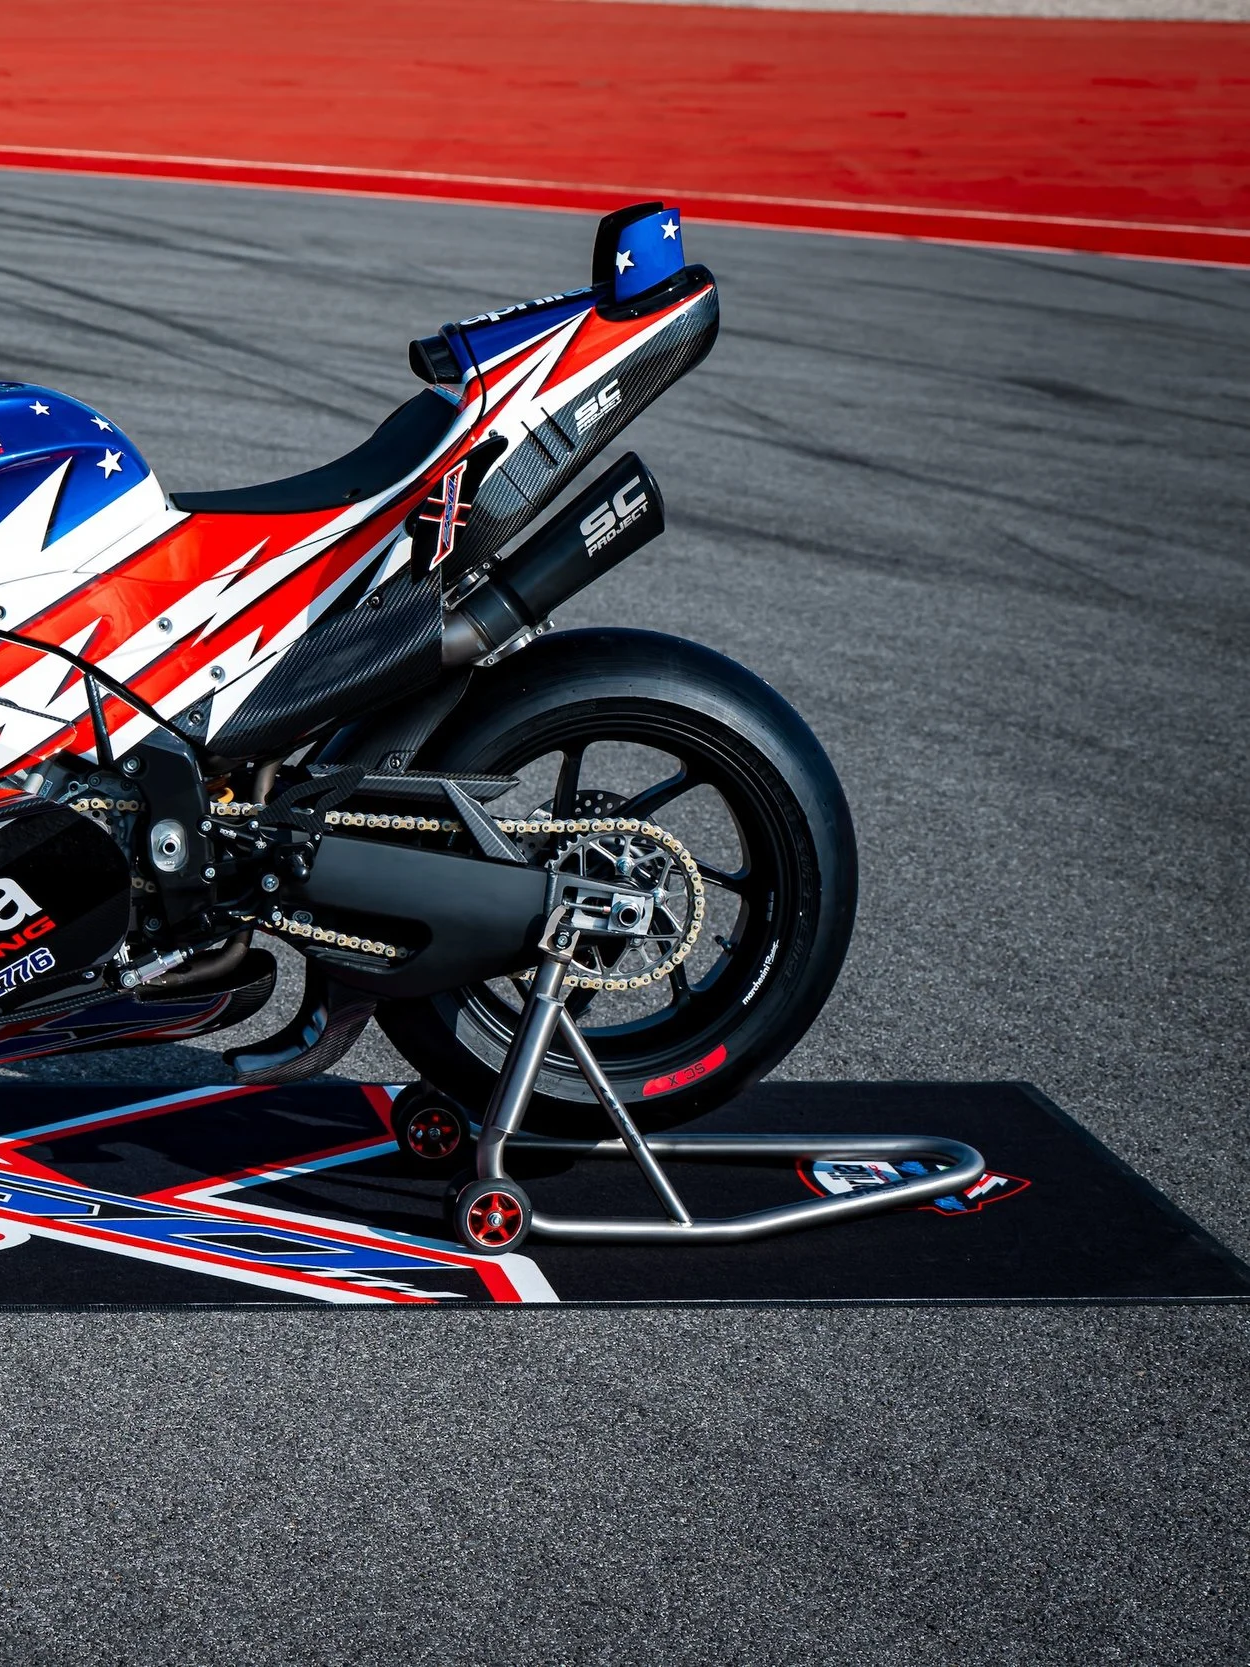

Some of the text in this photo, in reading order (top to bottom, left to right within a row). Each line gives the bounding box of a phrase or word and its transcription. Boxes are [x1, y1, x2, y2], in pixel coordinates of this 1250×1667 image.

[574, 378, 621, 428] SC
[579, 475, 647, 548] SC
[587, 500, 649, 558] PROJECT
[741, 963, 771, 1006] marchesini
